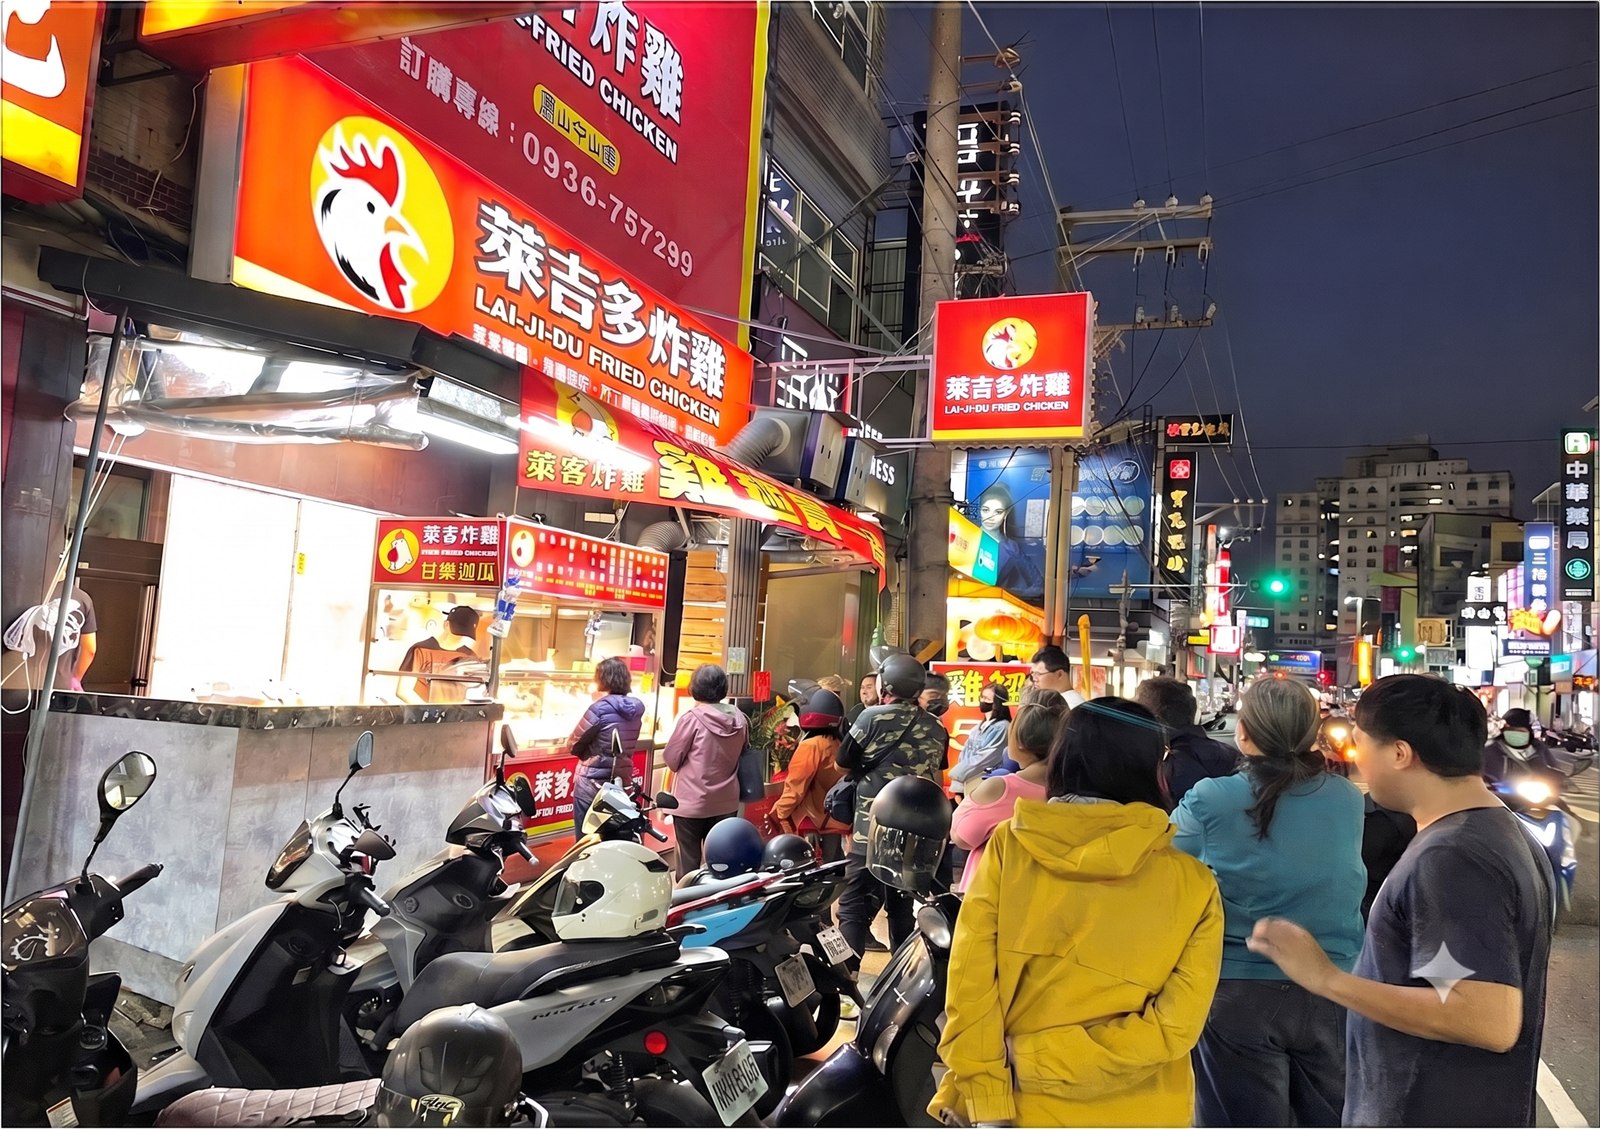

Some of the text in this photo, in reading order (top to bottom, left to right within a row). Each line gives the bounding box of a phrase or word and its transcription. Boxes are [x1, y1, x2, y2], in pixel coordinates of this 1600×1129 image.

[531, 15, 678, 164] FRIED CHICKEN
[562, 2, 684, 124] 炸雞
[474, 286, 584, 359] LAI-JI-DU
[587, 345, 645, 389] FRIED
[649, 379, 721, 428] CHICKEN
[476, 202, 727, 400] 萊吉多炸雞
[945, 372, 1070, 401] 萊吉多炸雞
[991, 401, 1021, 413] FRIED
[1023, 400, 1069, 411] CHICKEN
